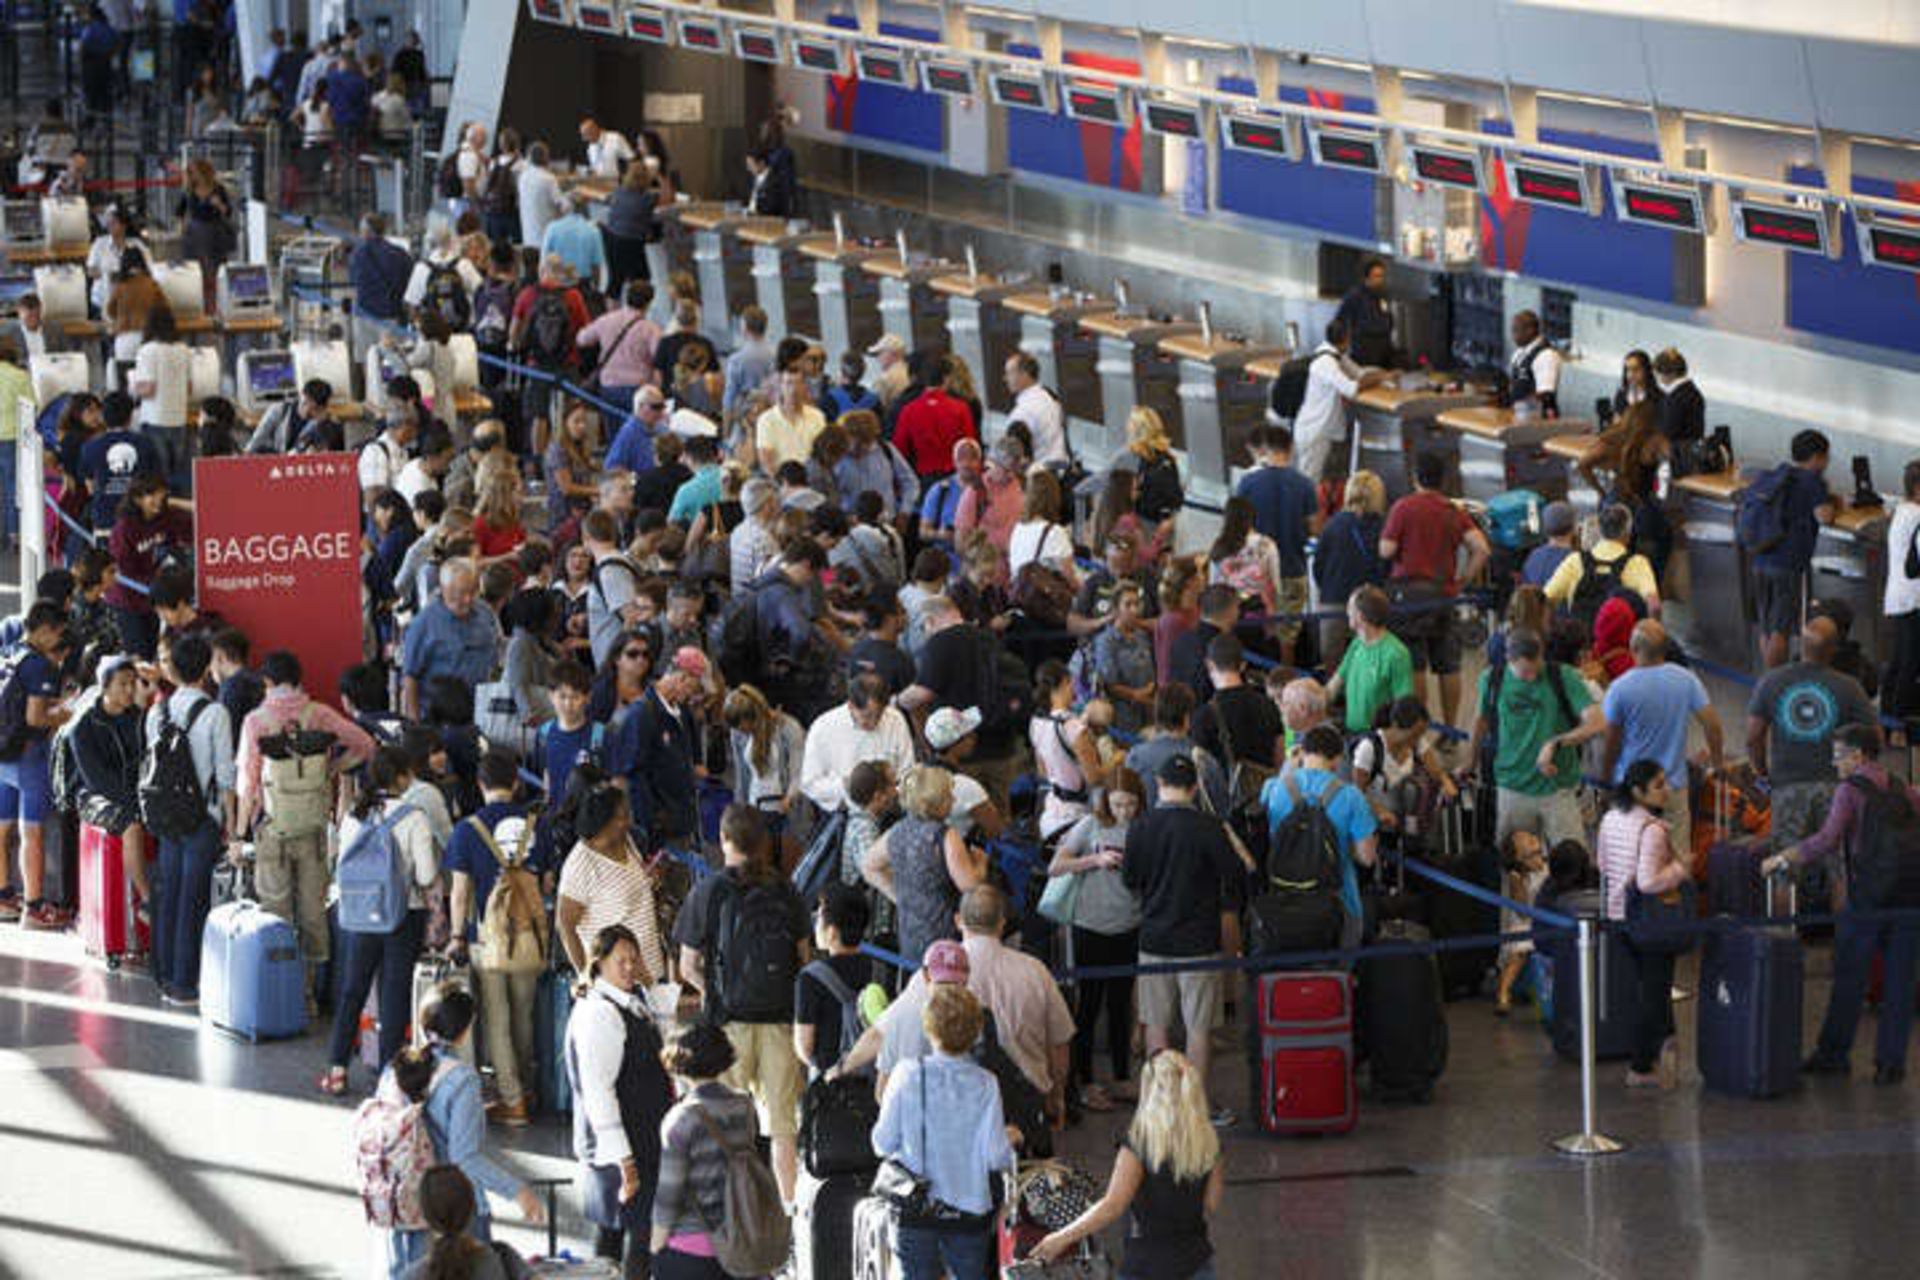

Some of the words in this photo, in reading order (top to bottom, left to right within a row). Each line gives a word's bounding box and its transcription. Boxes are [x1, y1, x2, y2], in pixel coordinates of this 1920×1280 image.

[285, 463, 334, 478] DELTA
[204, 532, 352, 565] BAGGAGE
[263, 572, 296, 588] Drop
